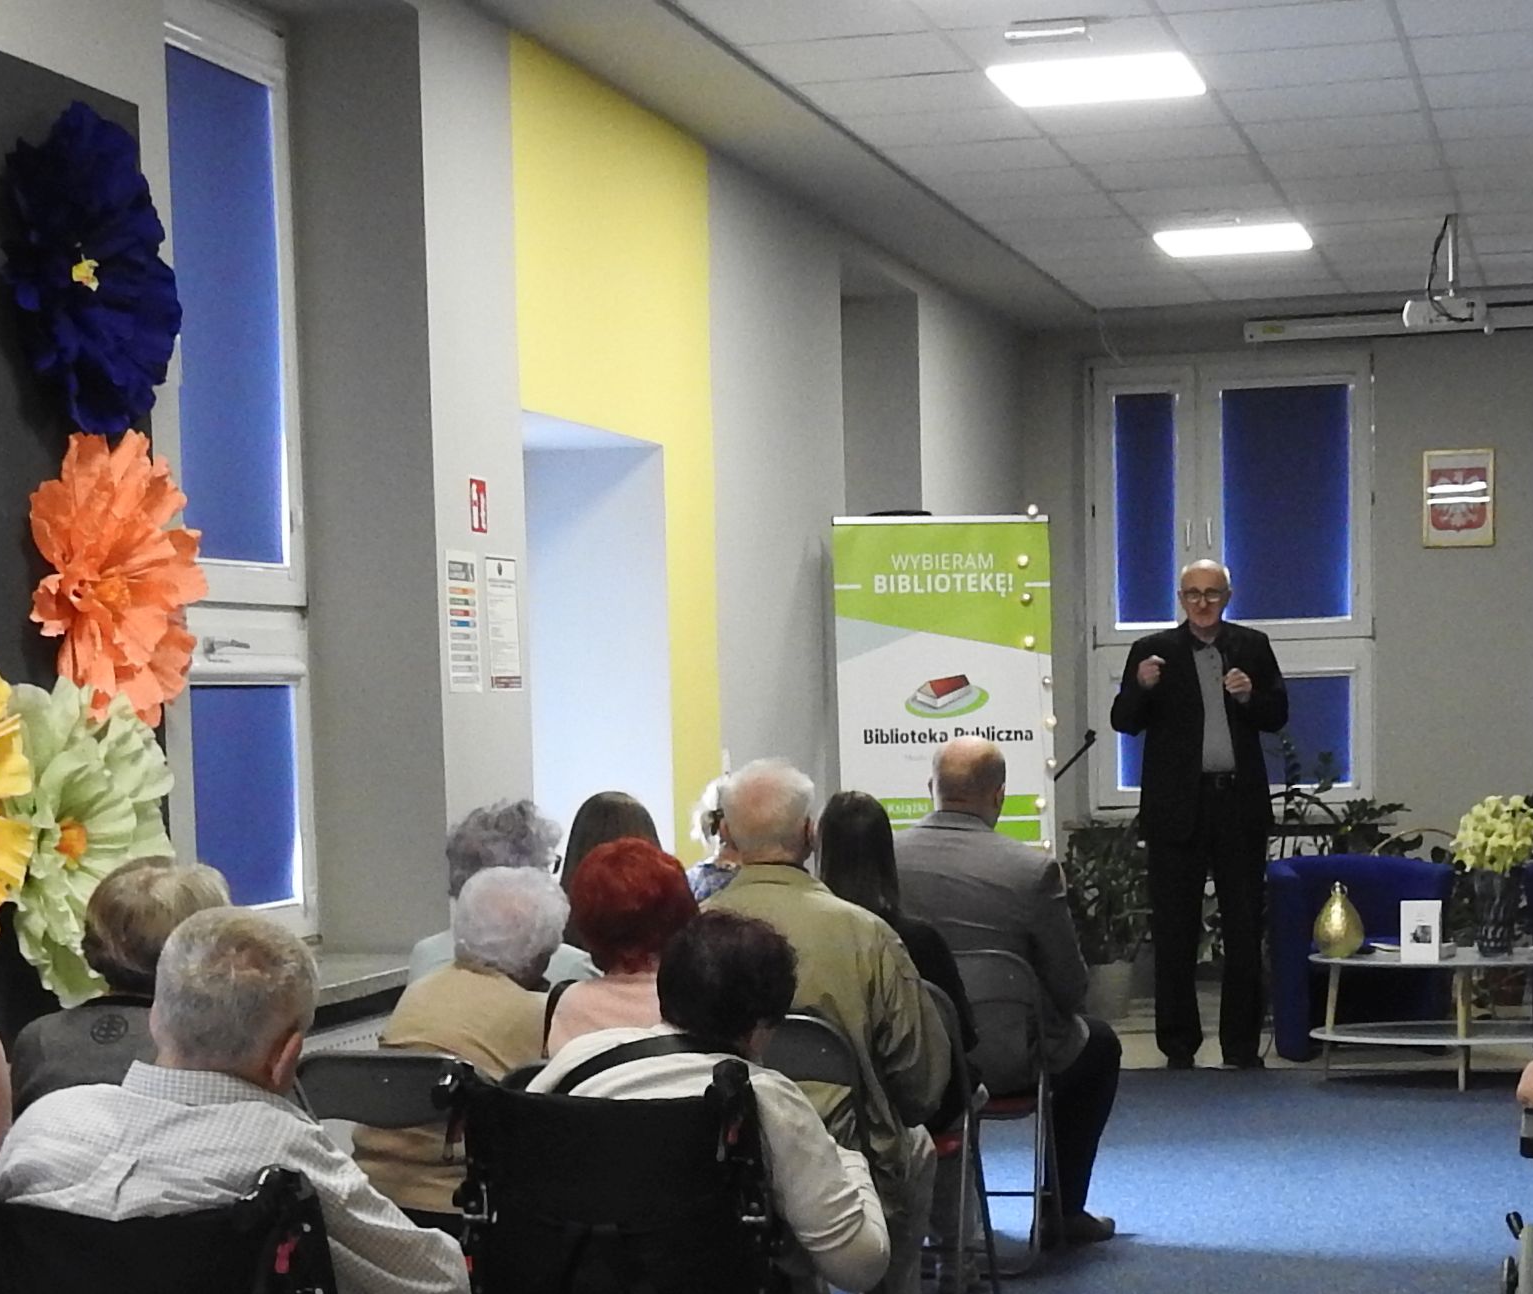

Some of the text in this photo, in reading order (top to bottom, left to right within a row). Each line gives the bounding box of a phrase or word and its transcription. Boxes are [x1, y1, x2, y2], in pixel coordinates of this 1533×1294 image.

[891, 553, 994, 571] WYBIERAM
[873, 573, 1014, 597] BIBLIOTEKĘ!
[863, 726, 1034, 745] Biblioteka Pbliczna
